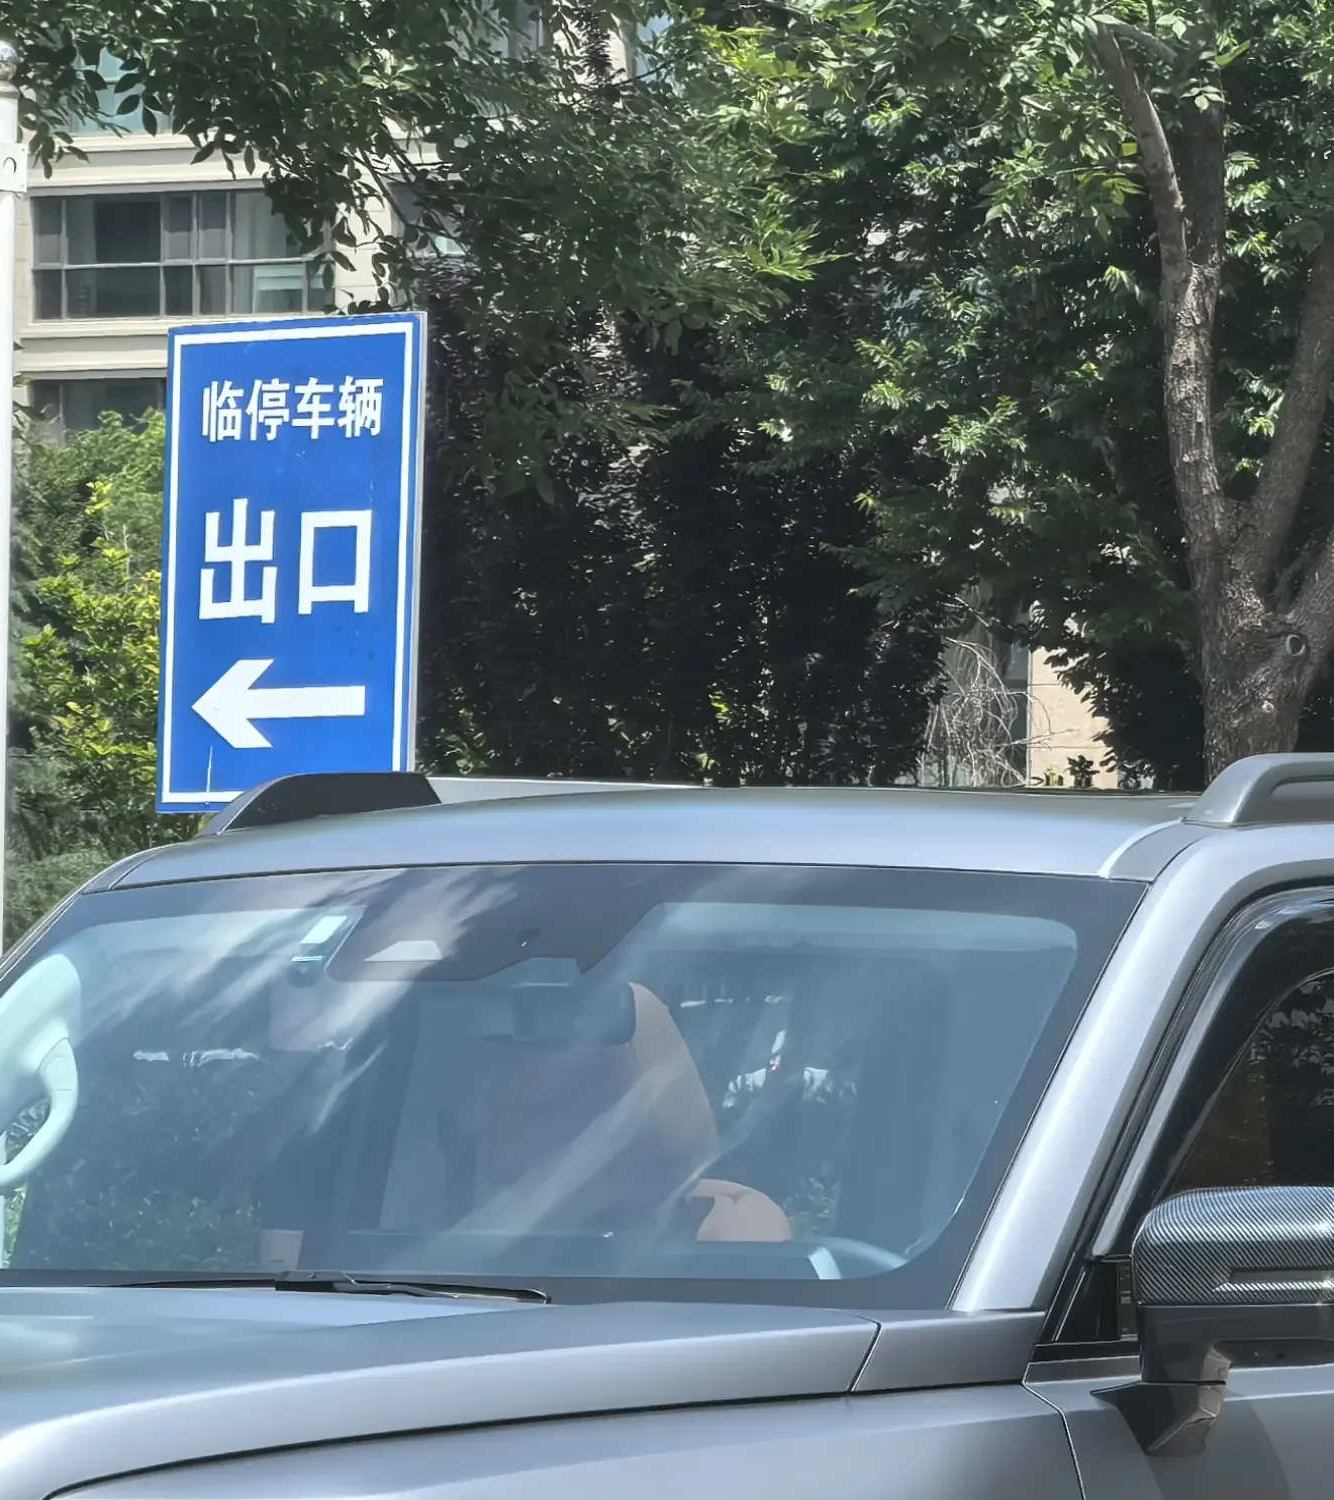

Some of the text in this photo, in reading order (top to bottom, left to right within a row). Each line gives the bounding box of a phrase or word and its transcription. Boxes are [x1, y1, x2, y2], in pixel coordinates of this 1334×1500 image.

[202, 376, 384, 443] 临停车辆
[199, 498, 372, 624] 出口
